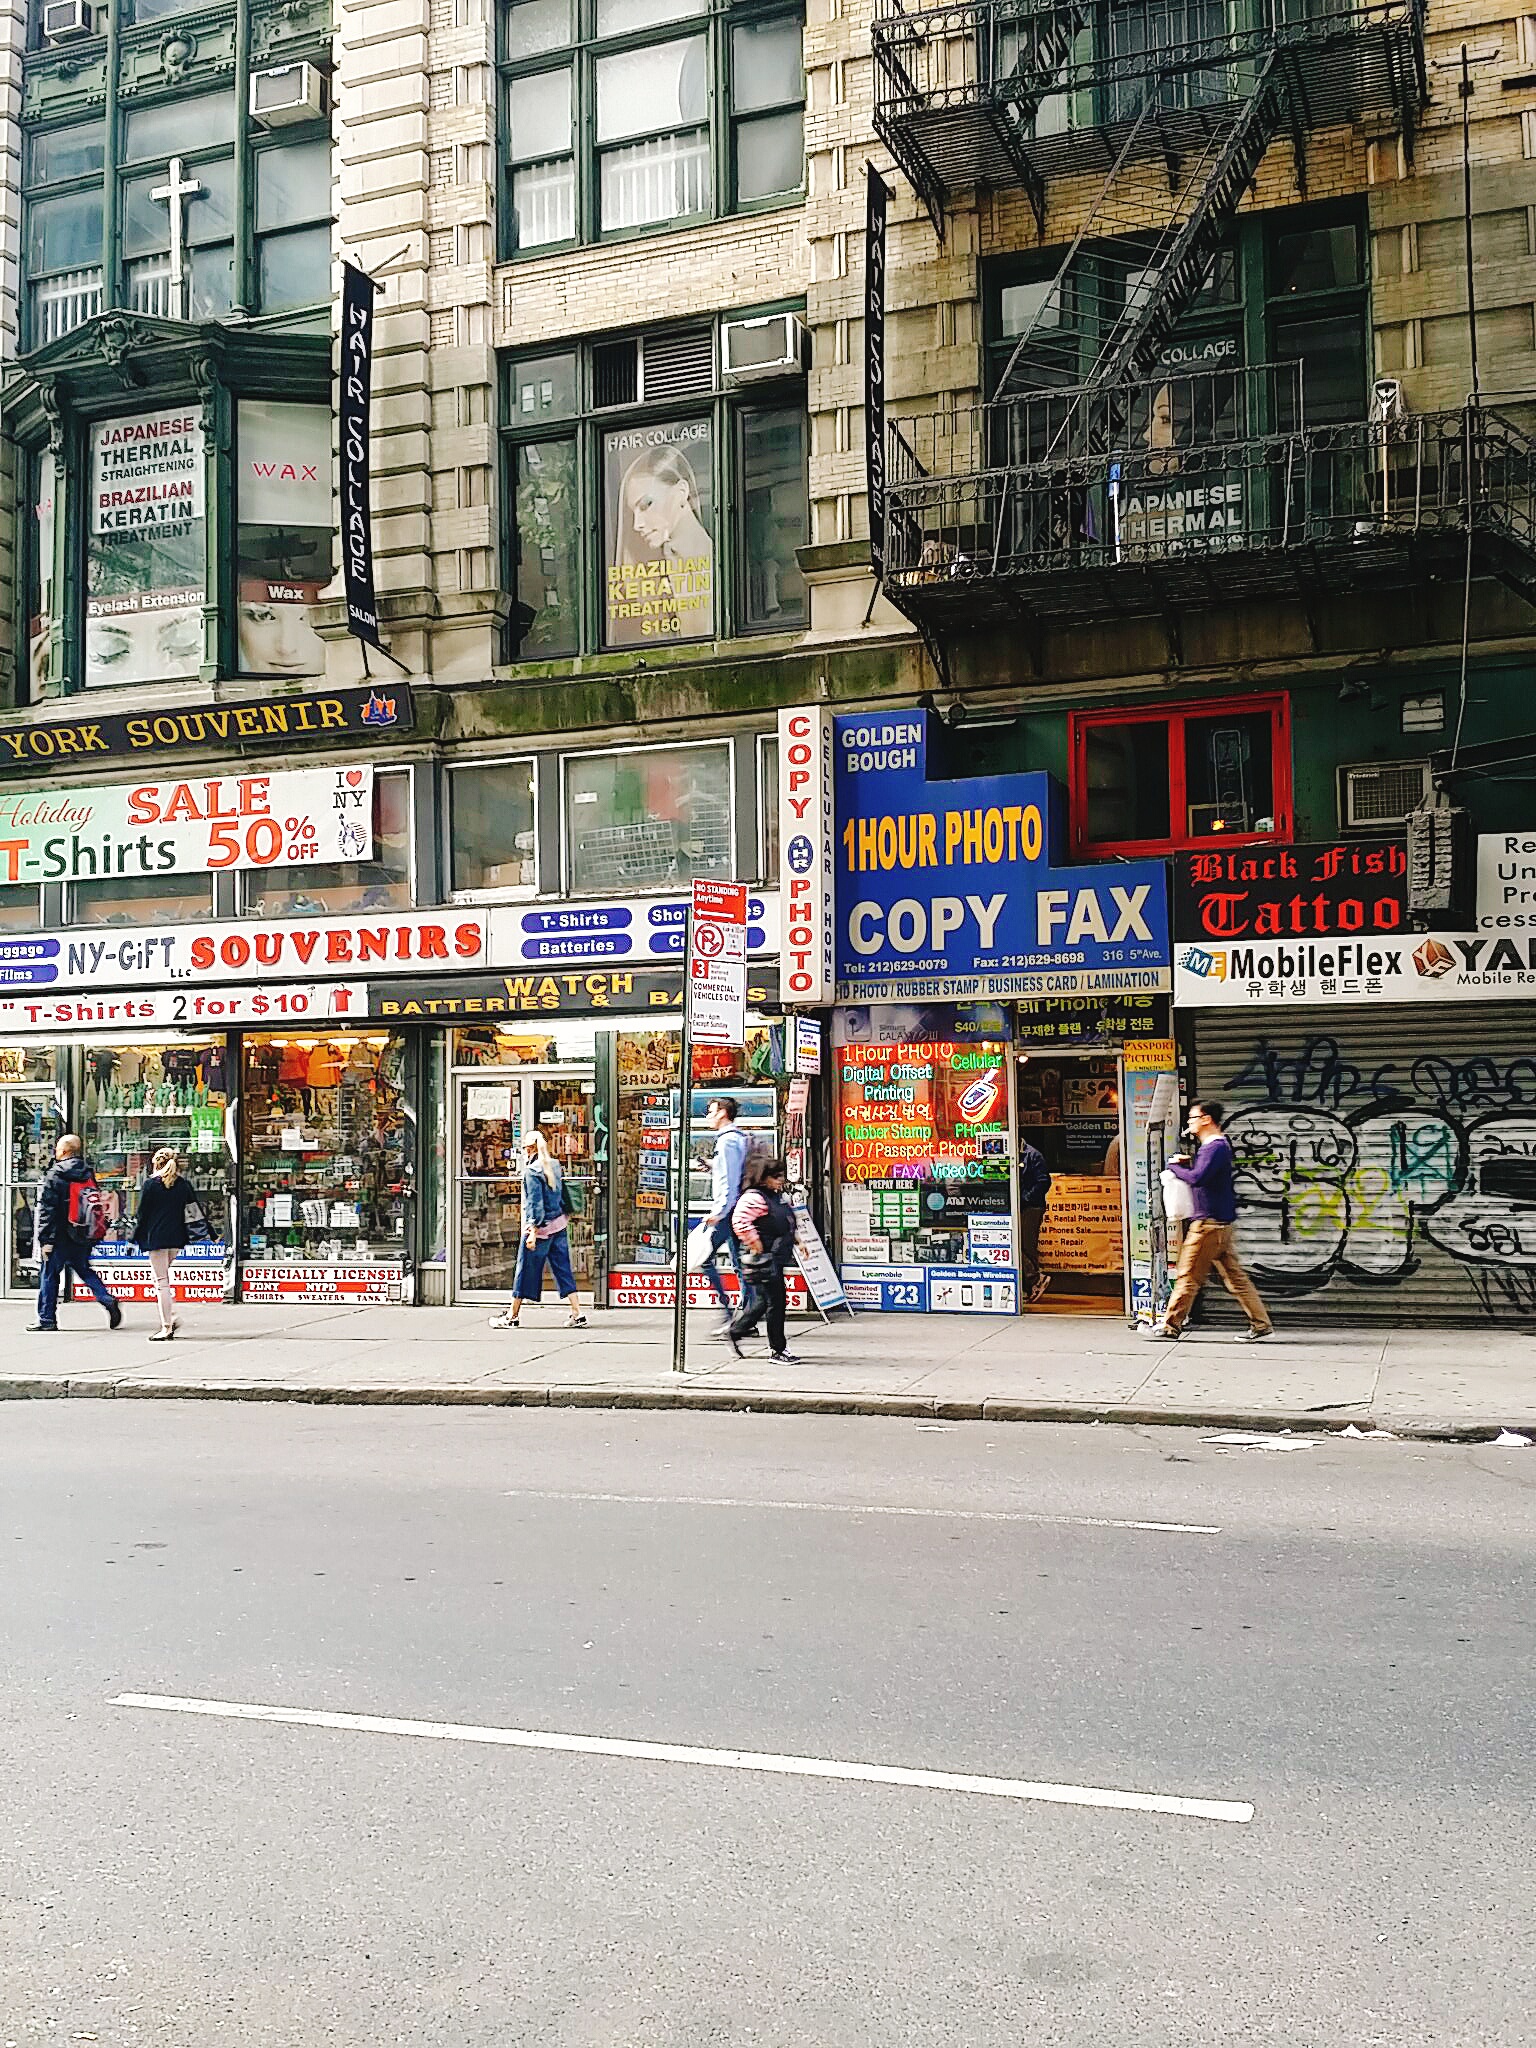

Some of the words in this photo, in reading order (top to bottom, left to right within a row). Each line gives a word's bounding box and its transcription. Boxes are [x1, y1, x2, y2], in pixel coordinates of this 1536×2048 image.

[871, 206, 882, 321] HAIR
[347, 303, 367, 404] HAIR
[1160, 339, 1236, 364] COLLAGE
[101, 417, 194, 446] JAPANESE
[870, 333, 882, 518] COLLAGE
[608, 432, 643, 451] HAIR
[646, 423, 708, 446] COLLAGE
[101, 440, 194, 467] THERMAL
[101, 458, 194, 482] STRAIGHTENING
[253, 462, 318, 481] WAX
[99, 480, 193, 508] BRAZILIAN
[345, 416, 367, 583] COLLAGE
[99, 500, 193, 529] KERATIN
[99, 522, 193, 546] TREATMENT
[607, 556, 710, 582] BRAZILIAN
[268, 585, 303, 600] Wax
[608, 573, 711, 601] KERATIN
[88, 595, 138, 617] Eyelash
[141, 590, 204, 610] Extension
[608, 595, 709, 619] TREATMENT
[349, 604, 376, 627] SALON
[640, 617, 681, 636] $150
[2, 724, 109, 759] YORK
[127, 699, 348, 747] SOUVENIR
[841, 723, 923, 749] GOLDEN
[787, 716, 811, 819] COPY
[846, 748, 917, 773] BOUGH
[336, 771, 346, 788] I
[127, 776, 271, 826] SALE
[332, 790, 366, 809] NY
[822, 725, 832, 875] CELLULAR
[843, 812, 937, 872] 1HOUR
[945, 803, 1042, 866] PHOTO
[0, 834, 177, 881] T-Shirts
[287, 843, 319, 861] OFF
[1190, 851, 1299, 888] Black
[1310, 845, 1407, 883] Fish
[696, 894, 723, 905] Anytime
[706, 884, 739, 897] STANDING
[848, 893, 1008, 956] COPY
[1036, 885, 1154, 947] FAX
[1197, 891, 1401, 939] Tattoo
[190, 922, 484, 967] SOUVENIRS
[788, 879, 813, 993] PHOTO
[824, 892, 832, 984] PHONE
[539, 940, 615, 956] Batteries
[695, 961, 706, 978] 3
[844, 962, 866, 974] Tel:
[868, 958, 948, 974] 212)629-0079
[973, 957, 999, 969] Fax:
[1002, 951, 1085, 967] 212)629-8698
[1102, 949, 1125, 961] 316
[1231, 943, 1402, 980] MobileFlex
[170, 967, 192, 979] LLC
[1457, 971, 1512, 985] Mobile
[503, 971, 634, 998] WATCH
[693, 982, 735, 993] COMMERCIAL
[852, 983, 888, 1000] PHOTO
[896, 980, 940, 997] RUBBER
[943, 978, 979, 996] STAMP
[988, 976, 1044, 994] BUSINESS
[1046, 975, 1078, 992] CARD
[1086, 971, 1160, 990] LAMINATION
[1245, 980, 1307, 998] 유학생
[1319, 978, 1384, 996] 핸드폰
[382, 995, 561, 1016] BATTERIES
[591, 993, 610, 1007] &
[693, 990, 723, 1001] VEHICLES
[724, 994, 740, 1003] ONLY
[25, 1000, 156, 1023] T-Shirts
[171, 995, 188, 1021] 2
[193, 997, 241, 1015] for
[251, 993, 310, 1014] $10
[843, 1045, 851, 1062] 1
[855, 1045, 893, 1062] Hour
[897, 1042, 954, 1061] PHOTO
[1124, 1042, 1174, 1051] PASSPORT
[950, 1054, 1003, 1070] Cellular
[1124, 1054, 1172, 1063] PICTURES
[843, 1066, 885, 1084] Digital
[890, 1064, 933, 1081] Offset
[864, 1085, 914, 1104] Printing
[845, 1126, 889, 1141] Rubber
[891, 1124, 932, 1141] Stamp
[1065, 1122, 1101, 1130] Golden
[845, 1163, 889, 1182] COPY
[868, 1179, 894, 1190] PREPAY
[895, 1179, 914, 1190] HERE
[945, 1197, 966, 1206] AT&T
[967, 1196, 1006, 1206] Wireless
[1053, 1214, 1077, 1223] Rental
[1078, 1214, 1100, 1223] Phone
[1048, 1226, 1074, 1234] Phones
[1075, 1226, 1092, 1234] Sale
[1060, 1238, 1084, 1246] Repair
[988, 1249, 1010, 1261] $29
[1054, 1250, 1088, 1258] Unlocked
[113, 1270, 152, 1281] GLASSE
[173, 1270, 224, 1281] MAGNETS
[245, 1269, 327, 1280] OFFICIALLY
[621, 1274, 711, 1288] BATTEIES
[861, 1271, 903, 1279] Lycamobile
[930, 1270, 956, 1278] Golden
[957, 1271, 981, 1279] Bough
[982, 1271, 1015, 1280] Wireless
[249, 1282, 279, 1292] FDNY
[305, 1282, 337, 1292] NYPD
[887, 1284, 920, 1305] $23
[245, 1293, 285, 1301] T-SHIRTS
[298, 1294, 345, 1302] SWEATERS
[357, 1294, 381, 1302] TANK
[617, 1293, 697, 1305] CRYSTAS
